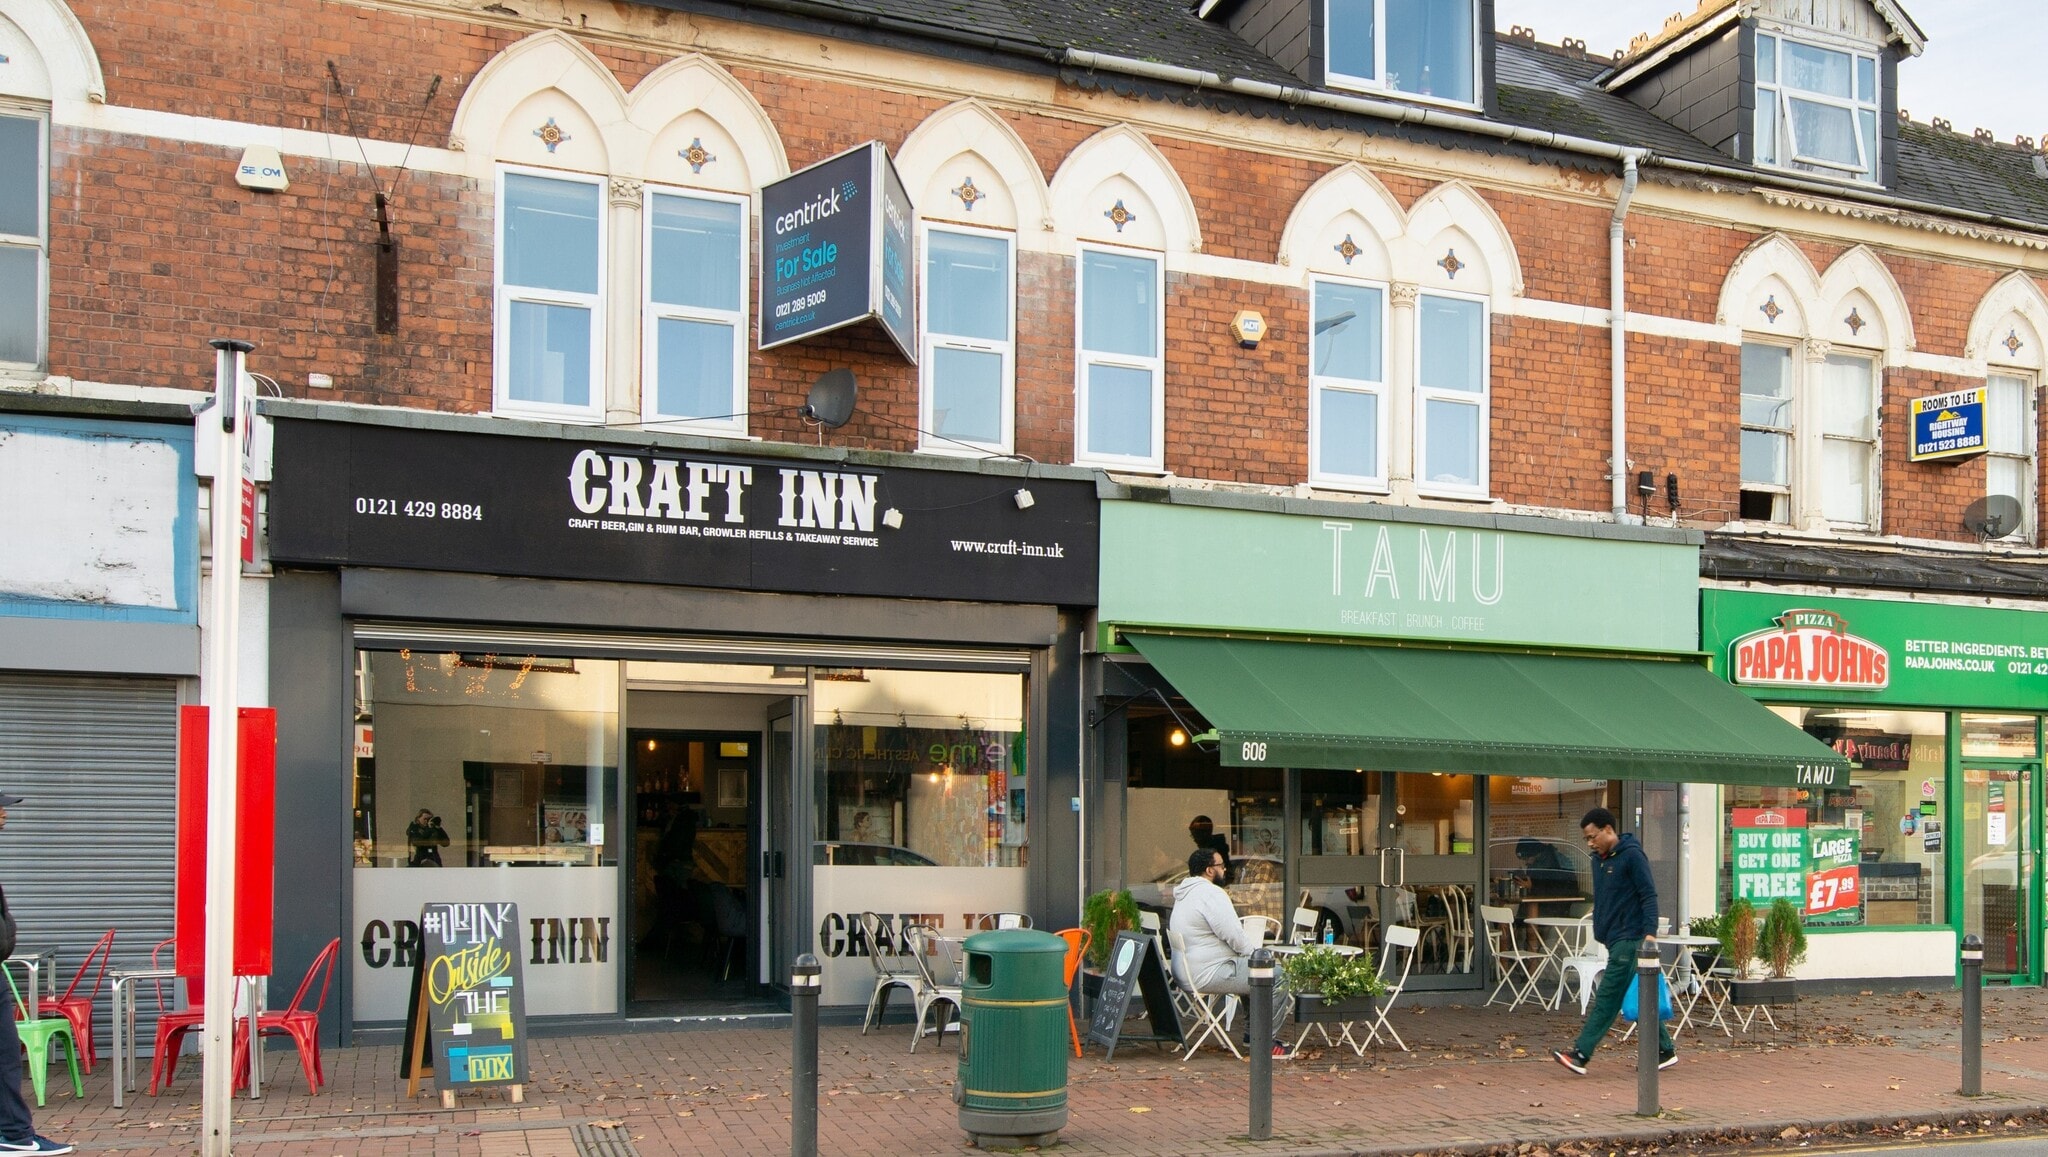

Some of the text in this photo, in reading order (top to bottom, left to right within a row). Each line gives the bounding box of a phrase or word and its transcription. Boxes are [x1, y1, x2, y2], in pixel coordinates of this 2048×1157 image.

[776, 188, 841, 234] centrick
[775, 233, 810, 253] Investment
[776, 241, 837, 281] For Sale
[777, 266, 836, 296] Business Not Affected
[776, 290, 826, 317] 0121 289 5009
[775, 311, 815, 331] centrick.co.uk
[1922, 392, 1976, 411] ROOMS TO LET
[1929, 417, 1968, 431] RIGHTWAY
[1932, 426, 1966, 440] HOUSING
[1918, 435, 1981, 454] 0121 523 8888
[567, 449, 877, 532] CRAFT INN
[356, 497, 482, 521] 0121 429 8884
[568, 518, 599, 529] CRAFT
[646, 523, 654, 533] &
[656, 524, 677, 535] RUM
[679, 526, 701, 537] BAR,
[703, 527, 747, 539] GROWLER
[748, 530, 784, 541] REFILLS
[785, 533, 793, 542] &
[795, 533, 841, 545] TAKEAWAY
[842, 536, 879, 547] SERVICE
[950, 537, 1064, 558] www.craft-inn.uk
[1322, 521, 1504, 605] TAMU
[1341, 610, 1485, 631] BREAKFAST BRUNCH COFFEE
[1795, 614, 1833, 627] PIZZA
[1739, 635, 1803, 680] PAPA
[1905, 639, 1948, 653] BETTER
[1951, 642, 2028, 658] INGREDIENTS.
[1905, 656, 1995, 672] PAPAJOHNS.CO.UK
[2008, 662, 2032, 674] 0121
[1242, 741, 1267, 761] 606
[1796, 764, 1835, 785] TAMU
[1738, 833, 1801, 848] BUY ONE
[1813, 838, 1853, 858] LARGE
[1738, 853, 1801, 868] GET ONE
[1833, 854, 1852, 864] PIZZA
[1738, 872, 1801, 898] FREE
[530, 917, 610, 964] INN
[819, 912, 945, 958] CRAFT
[428, 936, 511, 1004] Outside
[455, 990, 508, 1014] THE
[471, 1056, 510, 1080] BOX
